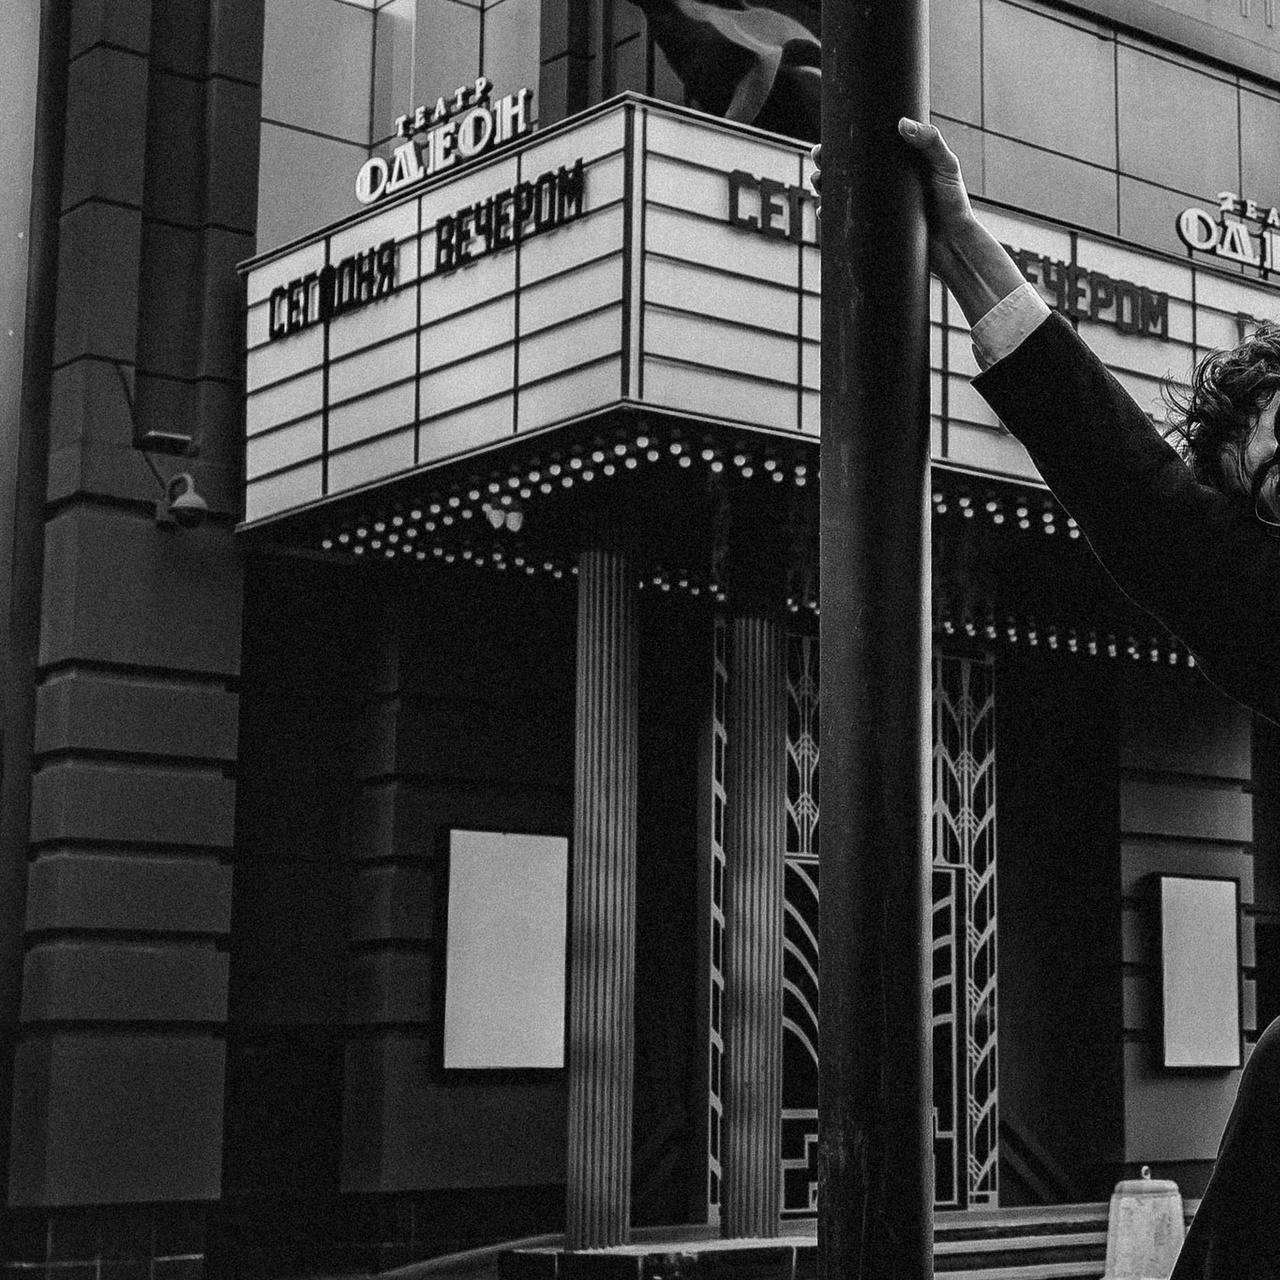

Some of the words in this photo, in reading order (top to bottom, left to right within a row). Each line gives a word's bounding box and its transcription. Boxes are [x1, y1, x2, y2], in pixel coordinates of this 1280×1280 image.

[355, 87, 530, 205] ОДЕОН
[395, 76, 491, 137] ТЕАТР
[269, 238, 396, 341] СЕГОДНЯ
[435, 158, 585, 271] ВЕЧЕРОМ
[728, 168, 821, 248] СЕГ
[1002, 242, 1169, 343] ЕЧЕРОМ
